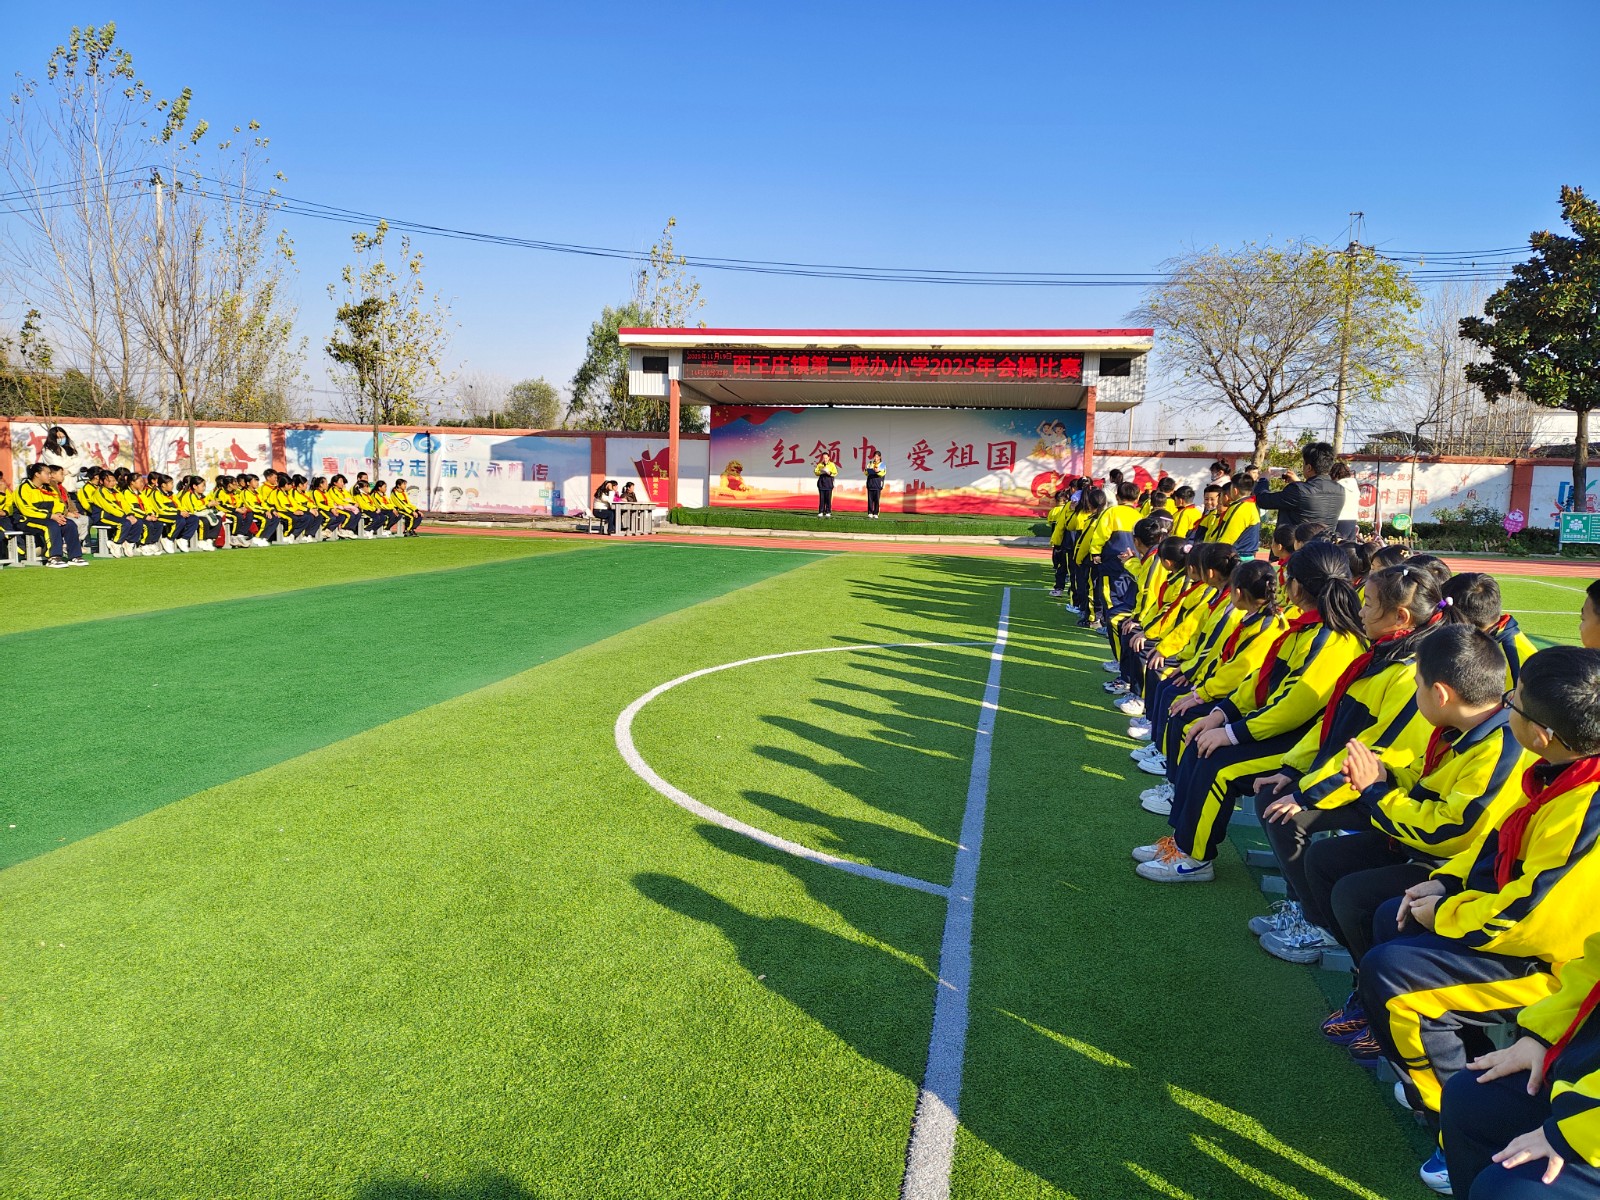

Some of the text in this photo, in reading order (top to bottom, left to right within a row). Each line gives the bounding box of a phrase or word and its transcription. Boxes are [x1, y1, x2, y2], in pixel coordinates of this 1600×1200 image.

[733, 354, 1081, 379] 西王庄镇第二联办小学2025年会操比赛
[771, 436, 1018, 473] 红领巾 爱祖国
